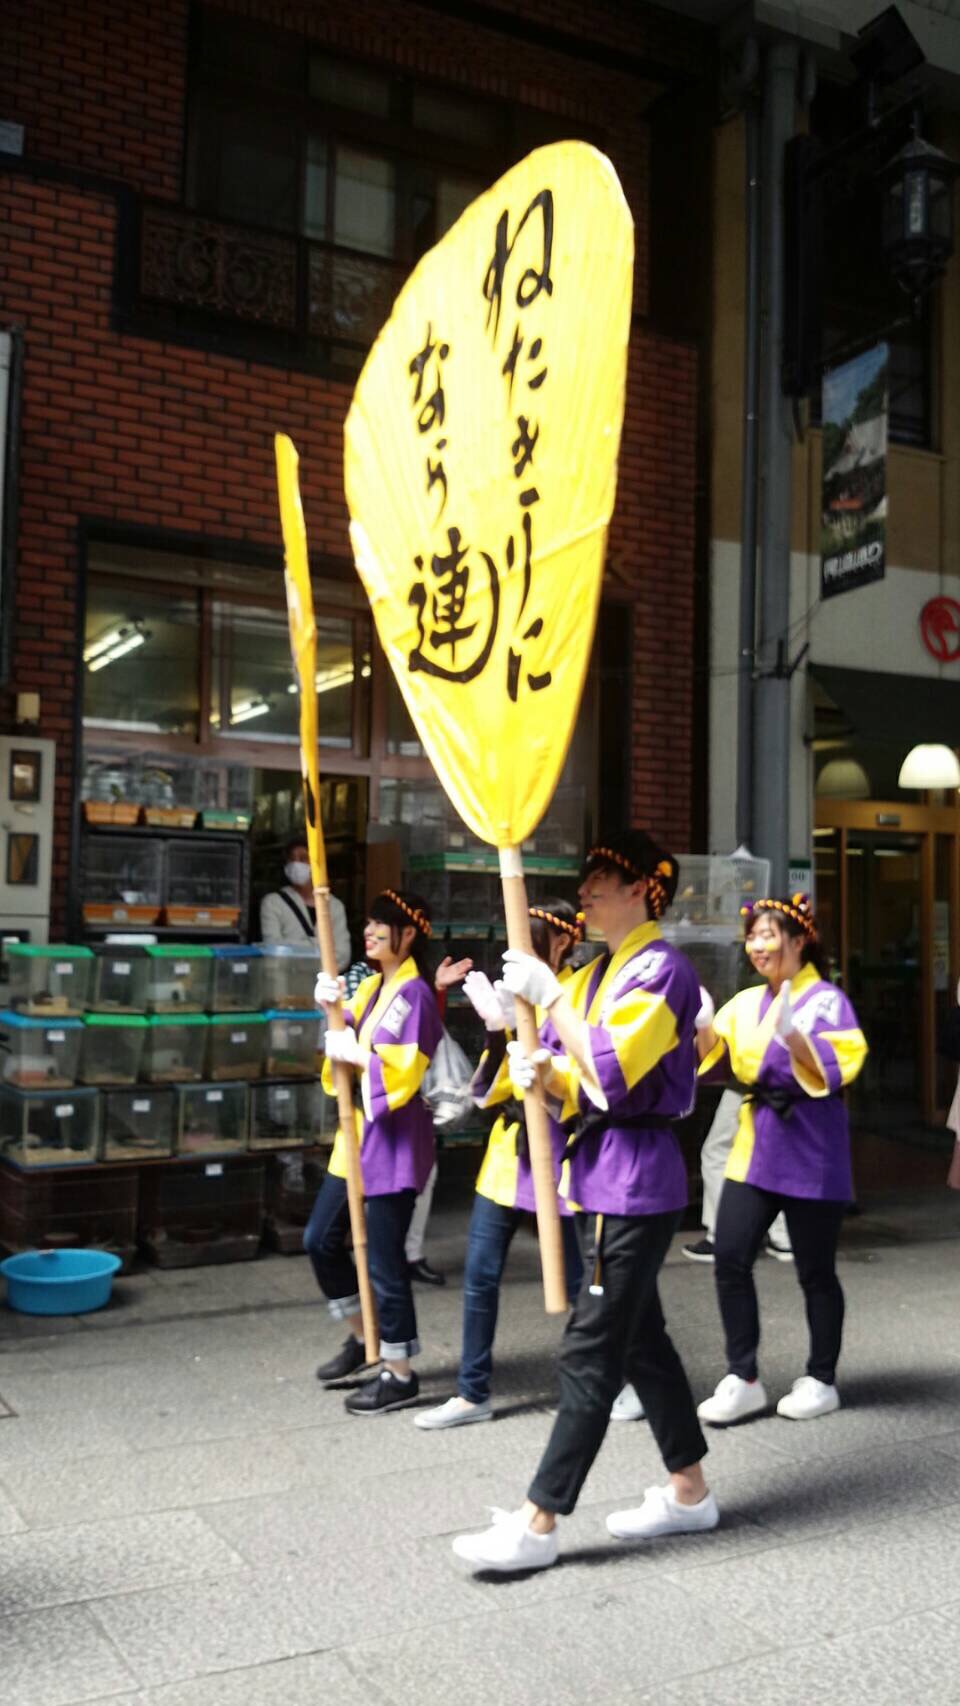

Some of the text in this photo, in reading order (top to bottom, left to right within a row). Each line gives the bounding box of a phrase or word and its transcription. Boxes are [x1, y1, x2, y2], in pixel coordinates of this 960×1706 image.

[482, 188, 554, 703] ねたきりに
